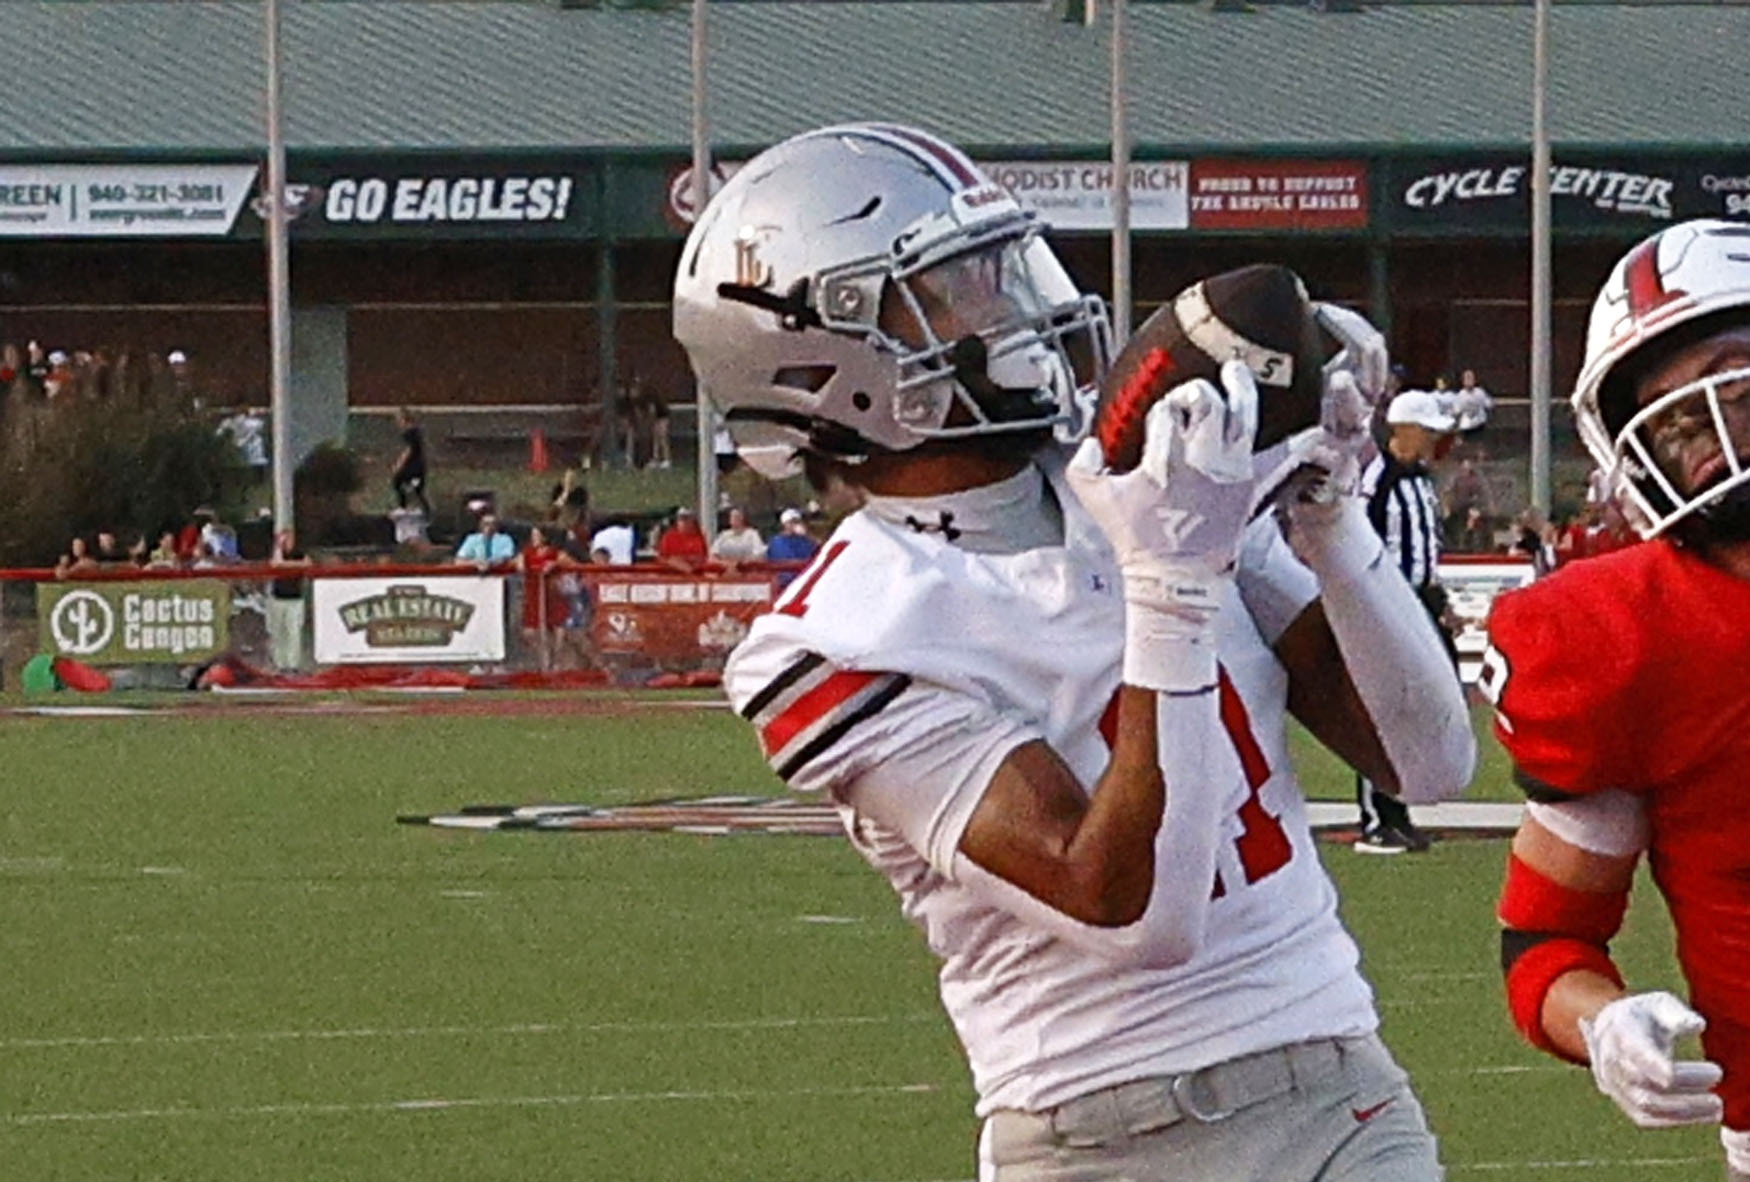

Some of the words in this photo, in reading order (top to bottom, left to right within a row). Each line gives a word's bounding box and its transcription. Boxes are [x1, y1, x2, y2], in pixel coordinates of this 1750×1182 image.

[1081, 168, 1182, 190] CHRCH
[1405, 167, 1526, 207] CYCLE
[1548, 165, 1674, 208] ENTER
[326, 178, 388, 222] GO
[391, 177, 574, 221] EAGLES!
[124, 594, 214, 623] Cactus
[343, 598, 394, 626] REAL
[399, 597, 467, 622] ESTATE
[124, 623, 214, 654] Canyon
